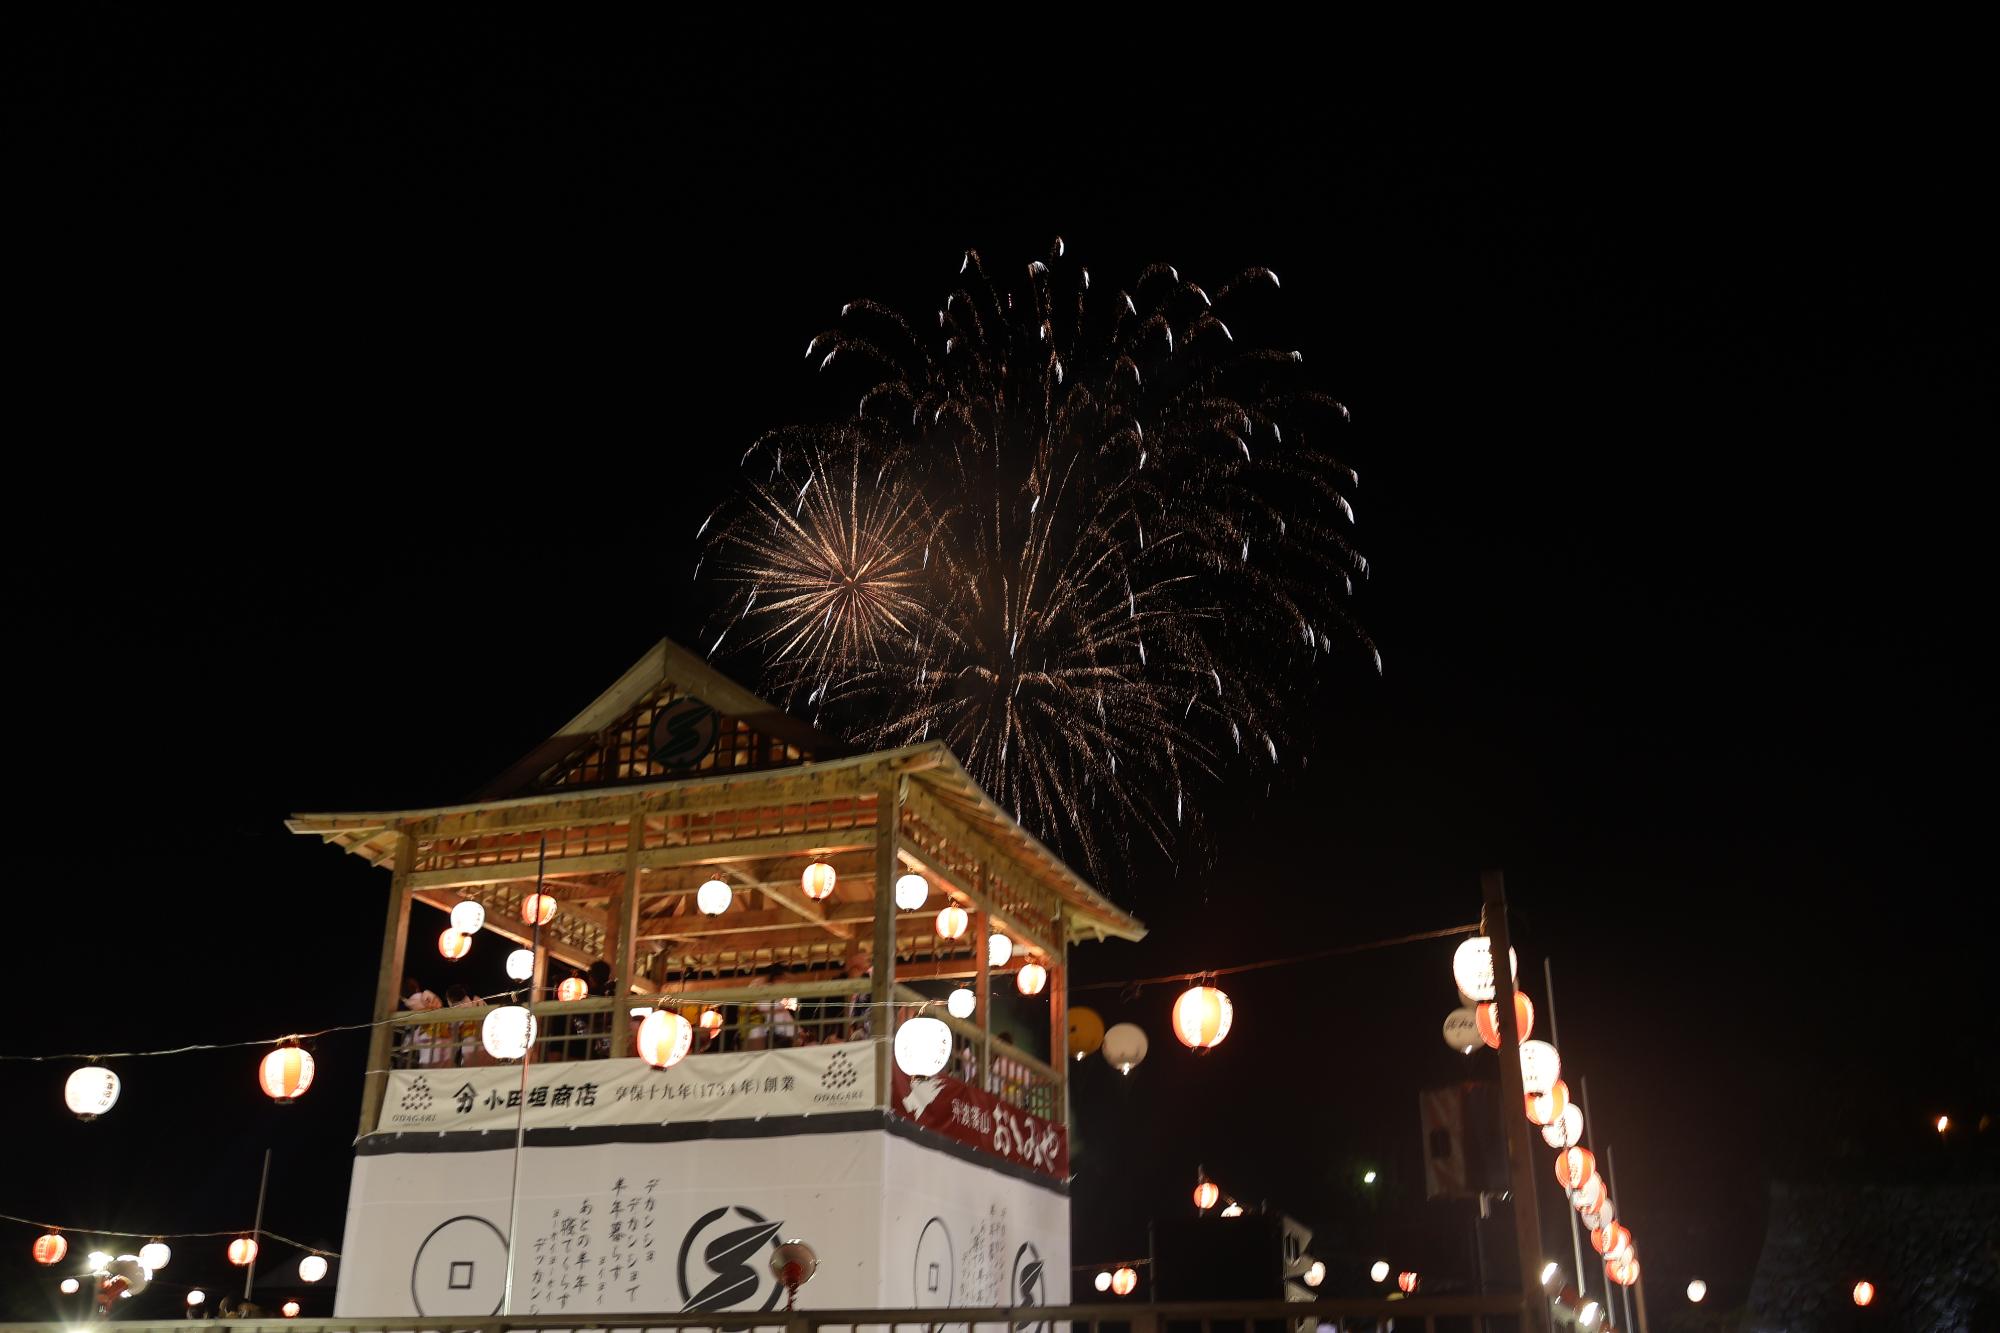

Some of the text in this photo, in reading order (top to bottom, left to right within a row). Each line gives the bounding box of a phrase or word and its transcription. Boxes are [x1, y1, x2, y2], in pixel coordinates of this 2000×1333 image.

[484, 1083, 599, 1111] 小田垣商店
[573, 1199, 593, 1294] あとの半年
[609, 1177, 628, 1281] 半年暮らす
